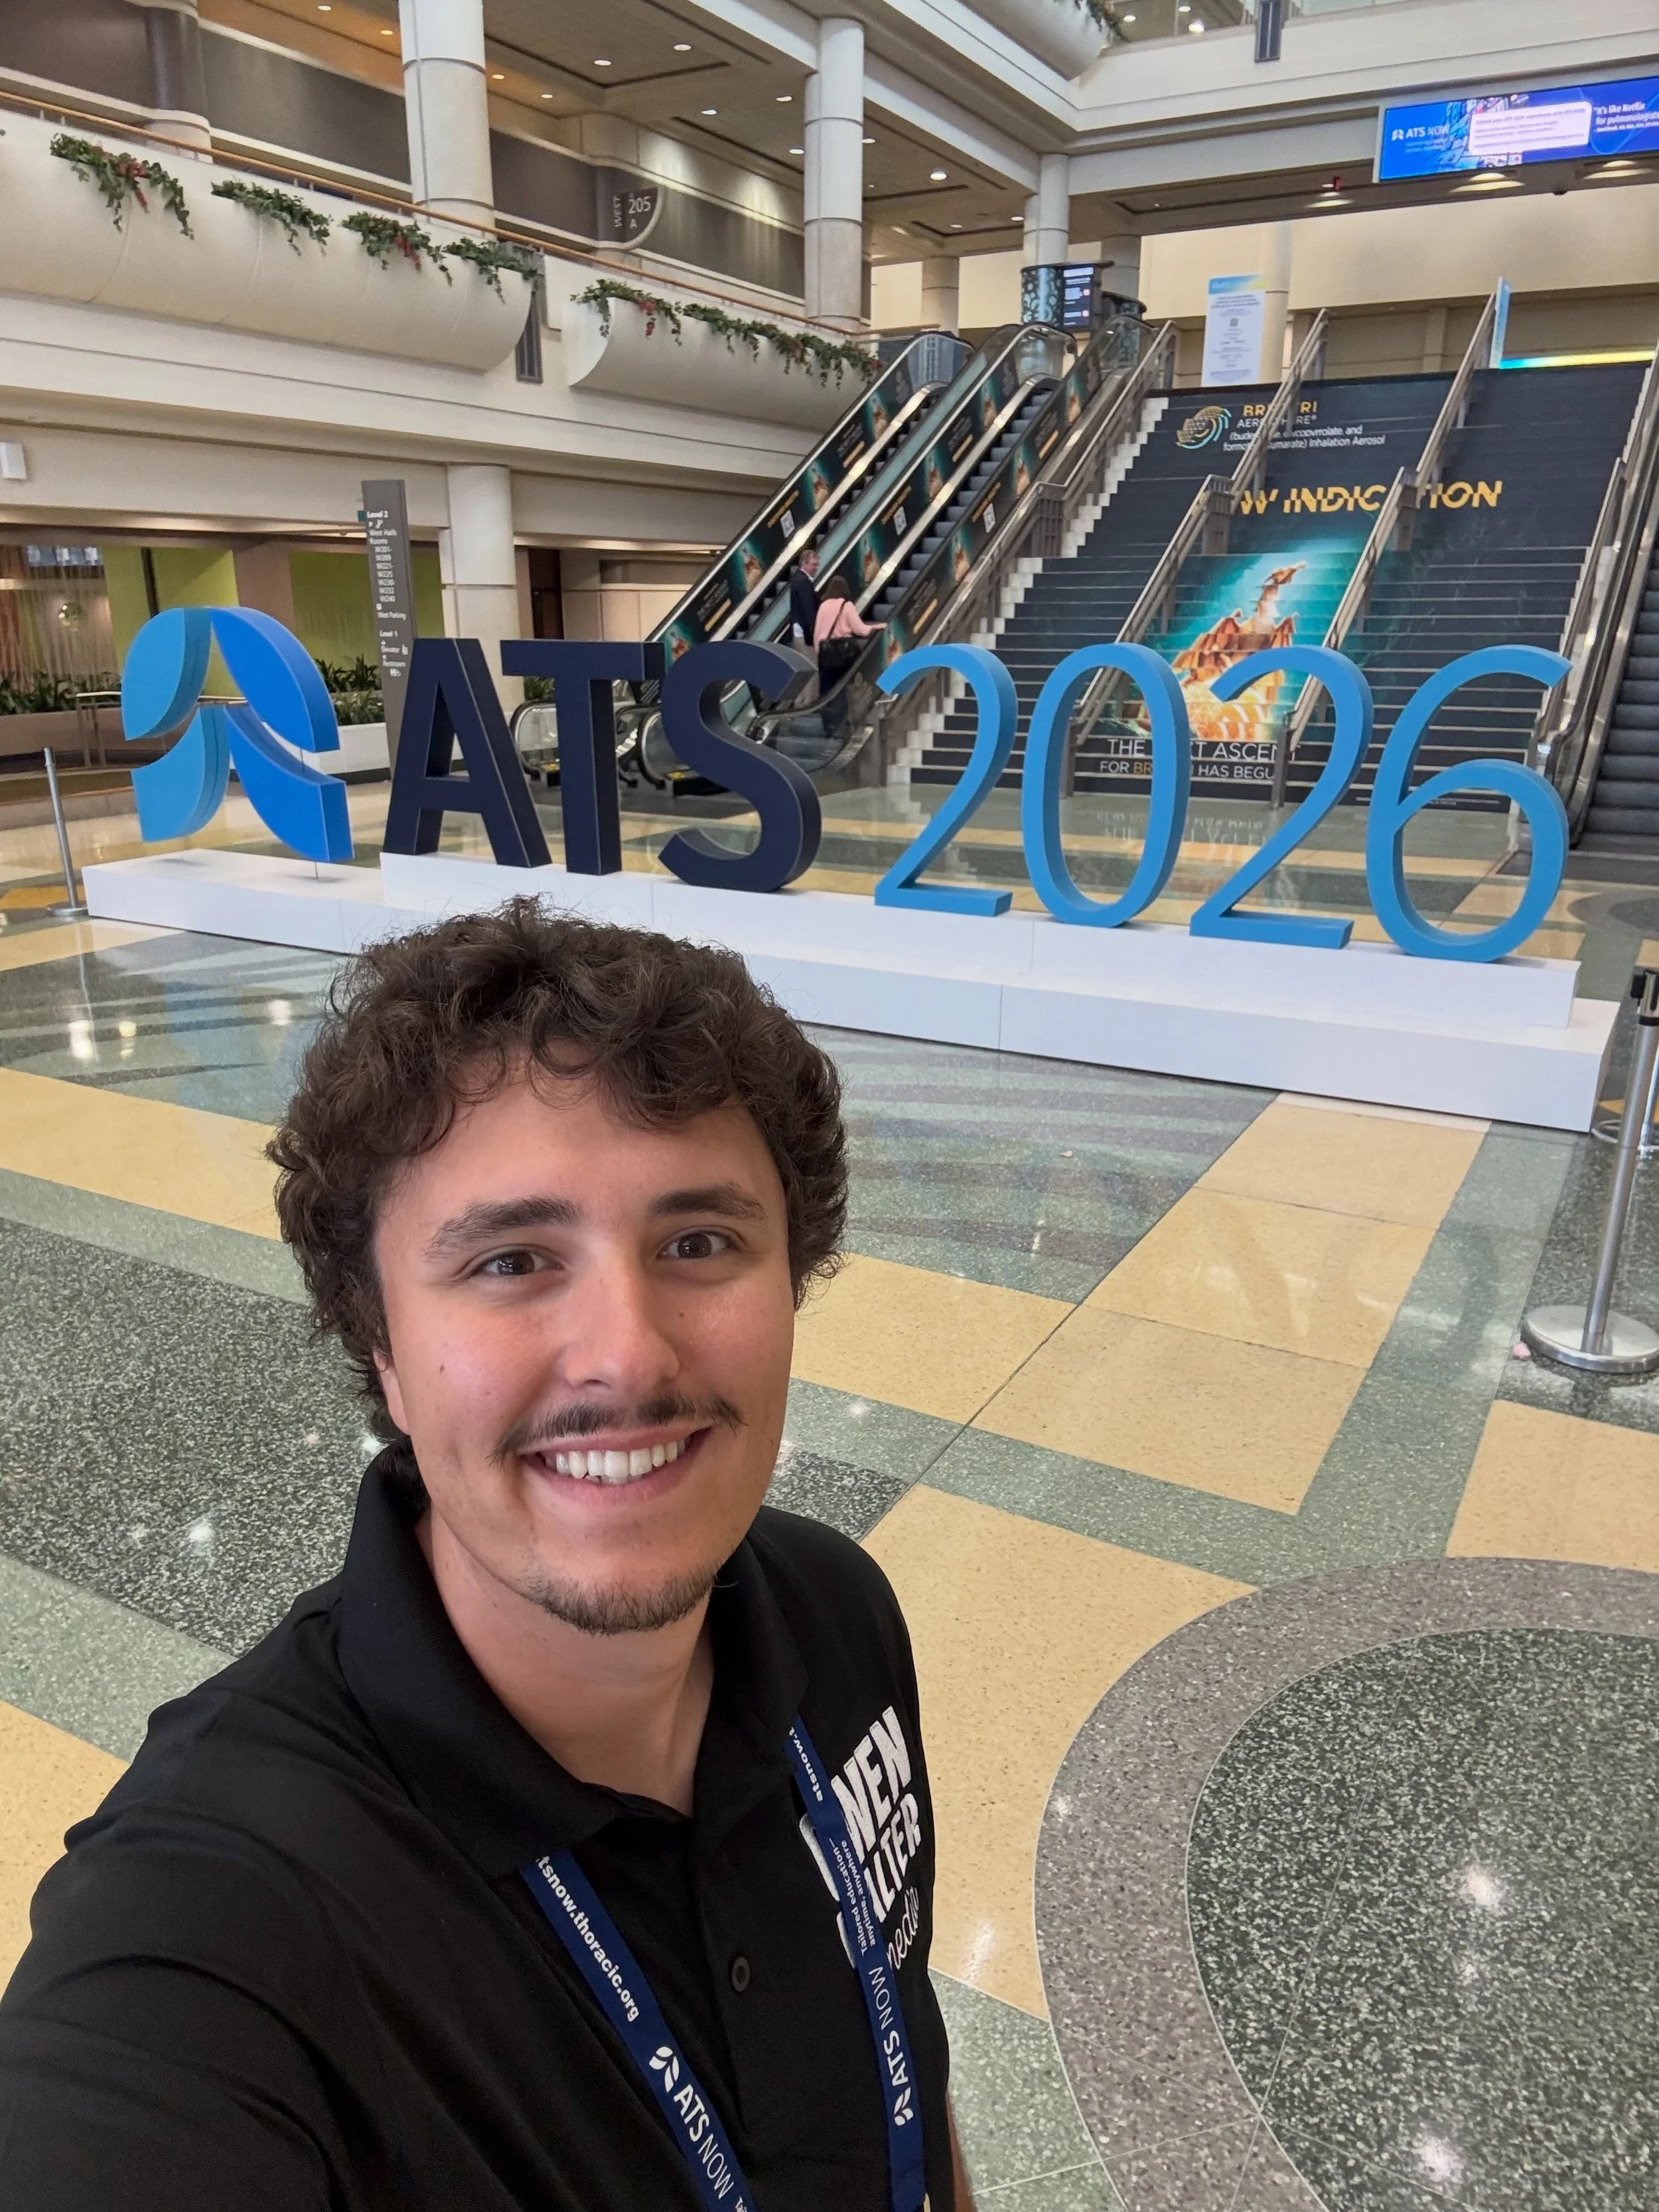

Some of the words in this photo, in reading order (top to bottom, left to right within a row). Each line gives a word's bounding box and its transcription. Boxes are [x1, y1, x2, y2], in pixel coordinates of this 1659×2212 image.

[1405, 127, 1426, 139] ATS
[1427, 124, 1450, 136] NOW
[613, 195, 622, 227] WEST
[628, 196, 651, 214] 205
[630, 218, 638, 229] A
[1243, 401, 1317, 417] BRRI
[1309, 437, 1350, 447] Inhalation
[1351, 435, 1386, 446] Aerosol
[1345, 425, 1363, 435] and
[1282, 480, 1503, 514] INDICION
[1107, 738, 1146, 757] THE
[1100, 760, 1130, 774] FOR
[1198, 764, 1229, 778] HAS
[1233, 765, 1275, 780] BEGU
[383, 638, 822, 893] ATS
[875, 642, 1572, 963] 2026
[841, 1839, 864, 1896] anywhere
[851, 1905, 868, 1957] Tailored
[860, 1896, 876, 1947] anytime,
[536, 1856, 640, 2023] tsnow.thoracic.org
[868, 1966, 894, 2030] NOW
[883, 2030, 908, 2087] ATS
[673, 2084, 710, 2142] ATS
[697, 2133, 735, 2200] NOW
